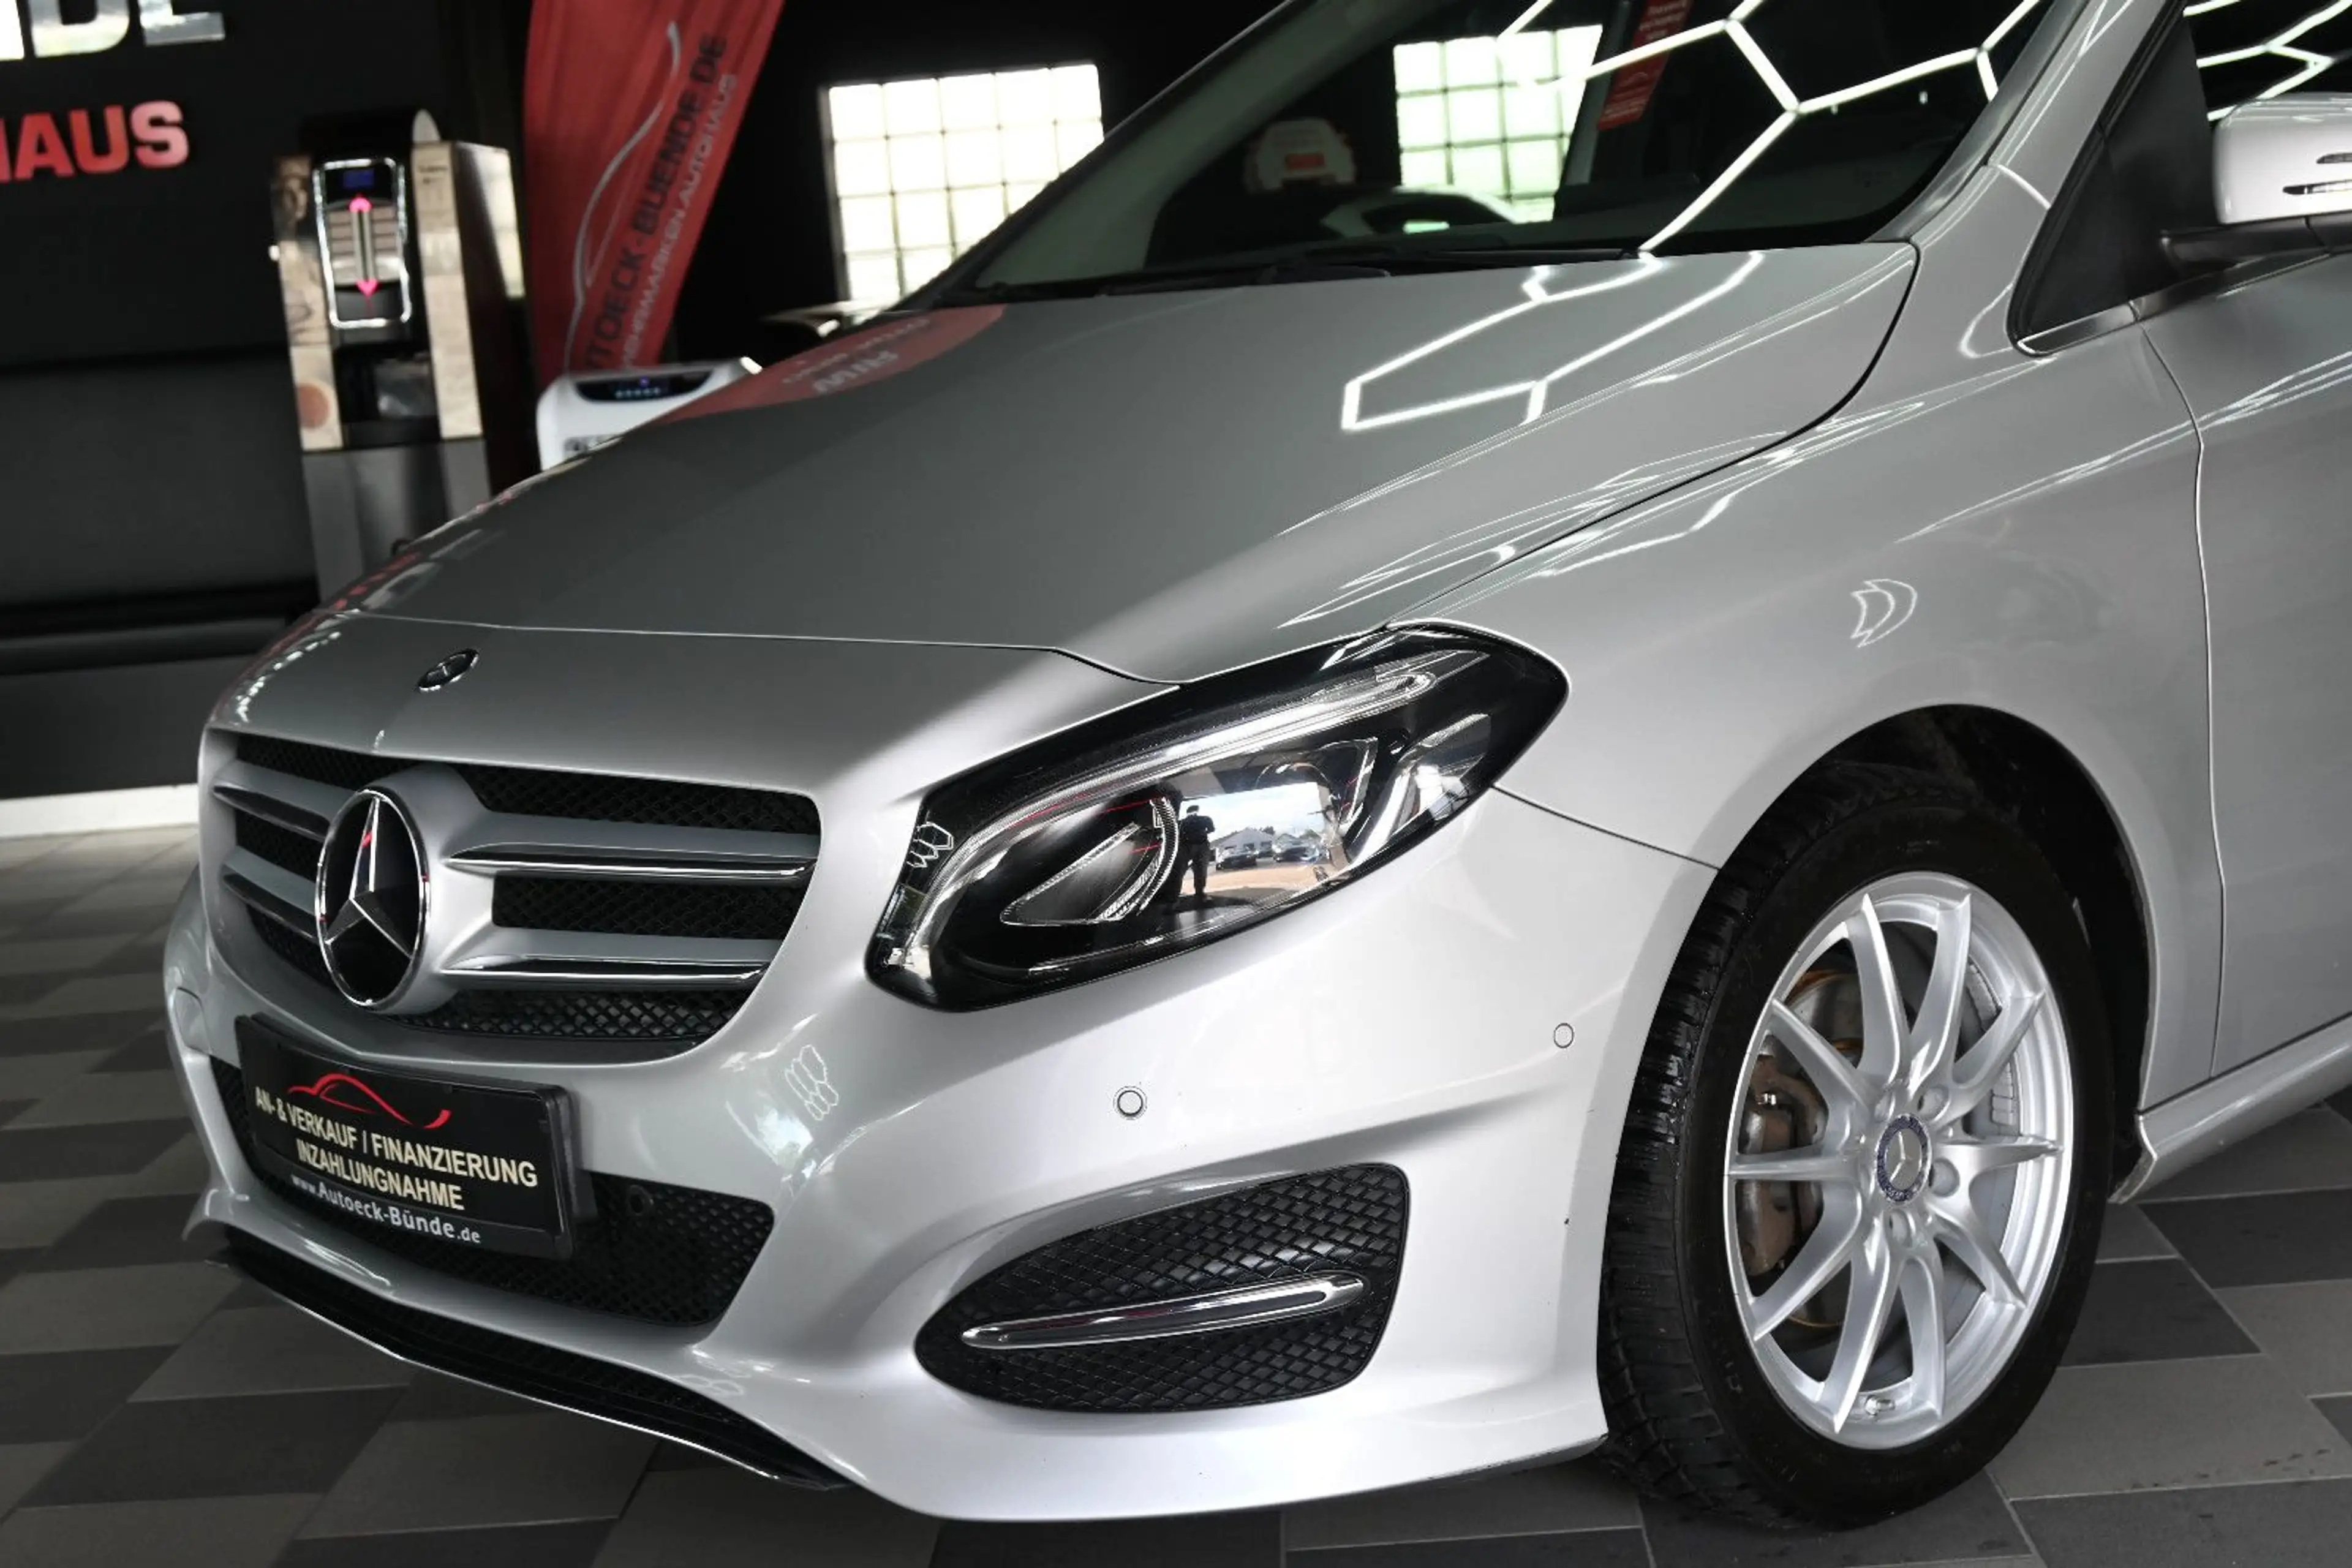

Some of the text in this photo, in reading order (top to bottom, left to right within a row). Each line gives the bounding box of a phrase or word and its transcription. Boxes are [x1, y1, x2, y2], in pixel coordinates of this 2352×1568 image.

[255, 1085, 276, 1115] AN-
[276, 1098, 288, 1123] &
[287, 1102, 358, 1150] VERKAUF
[371, 1133, 538, 1187] FINANZIERUNG
[296, 1137, 465, 1211] INZAHLUNGNAHME
